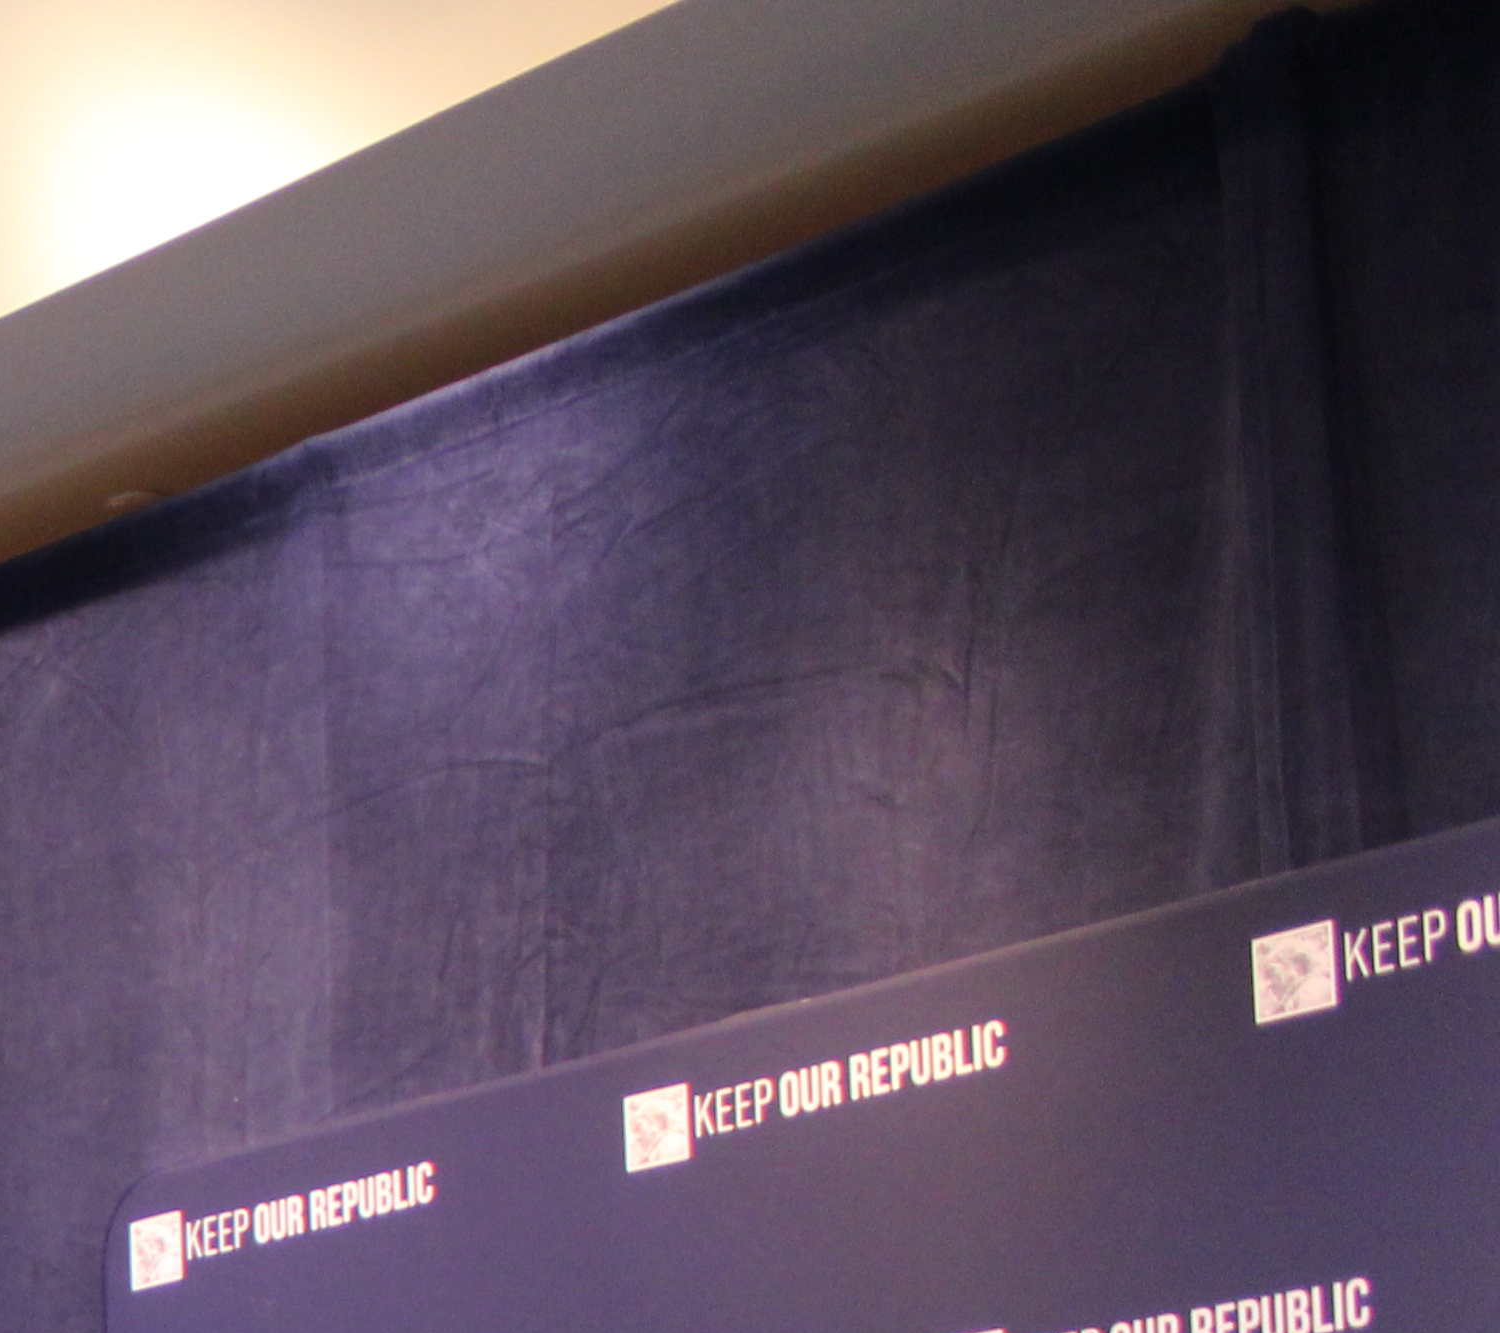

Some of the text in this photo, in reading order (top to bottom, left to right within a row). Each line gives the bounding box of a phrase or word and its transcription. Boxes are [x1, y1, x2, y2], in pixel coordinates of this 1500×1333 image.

[1344, 909, 1447, 981] KEEP
[694, 1020, 1005, 1138] KEEP OUR REPUBLIC
[186, 1162, 434, 1260] KEEP OUR REPUBLIC
